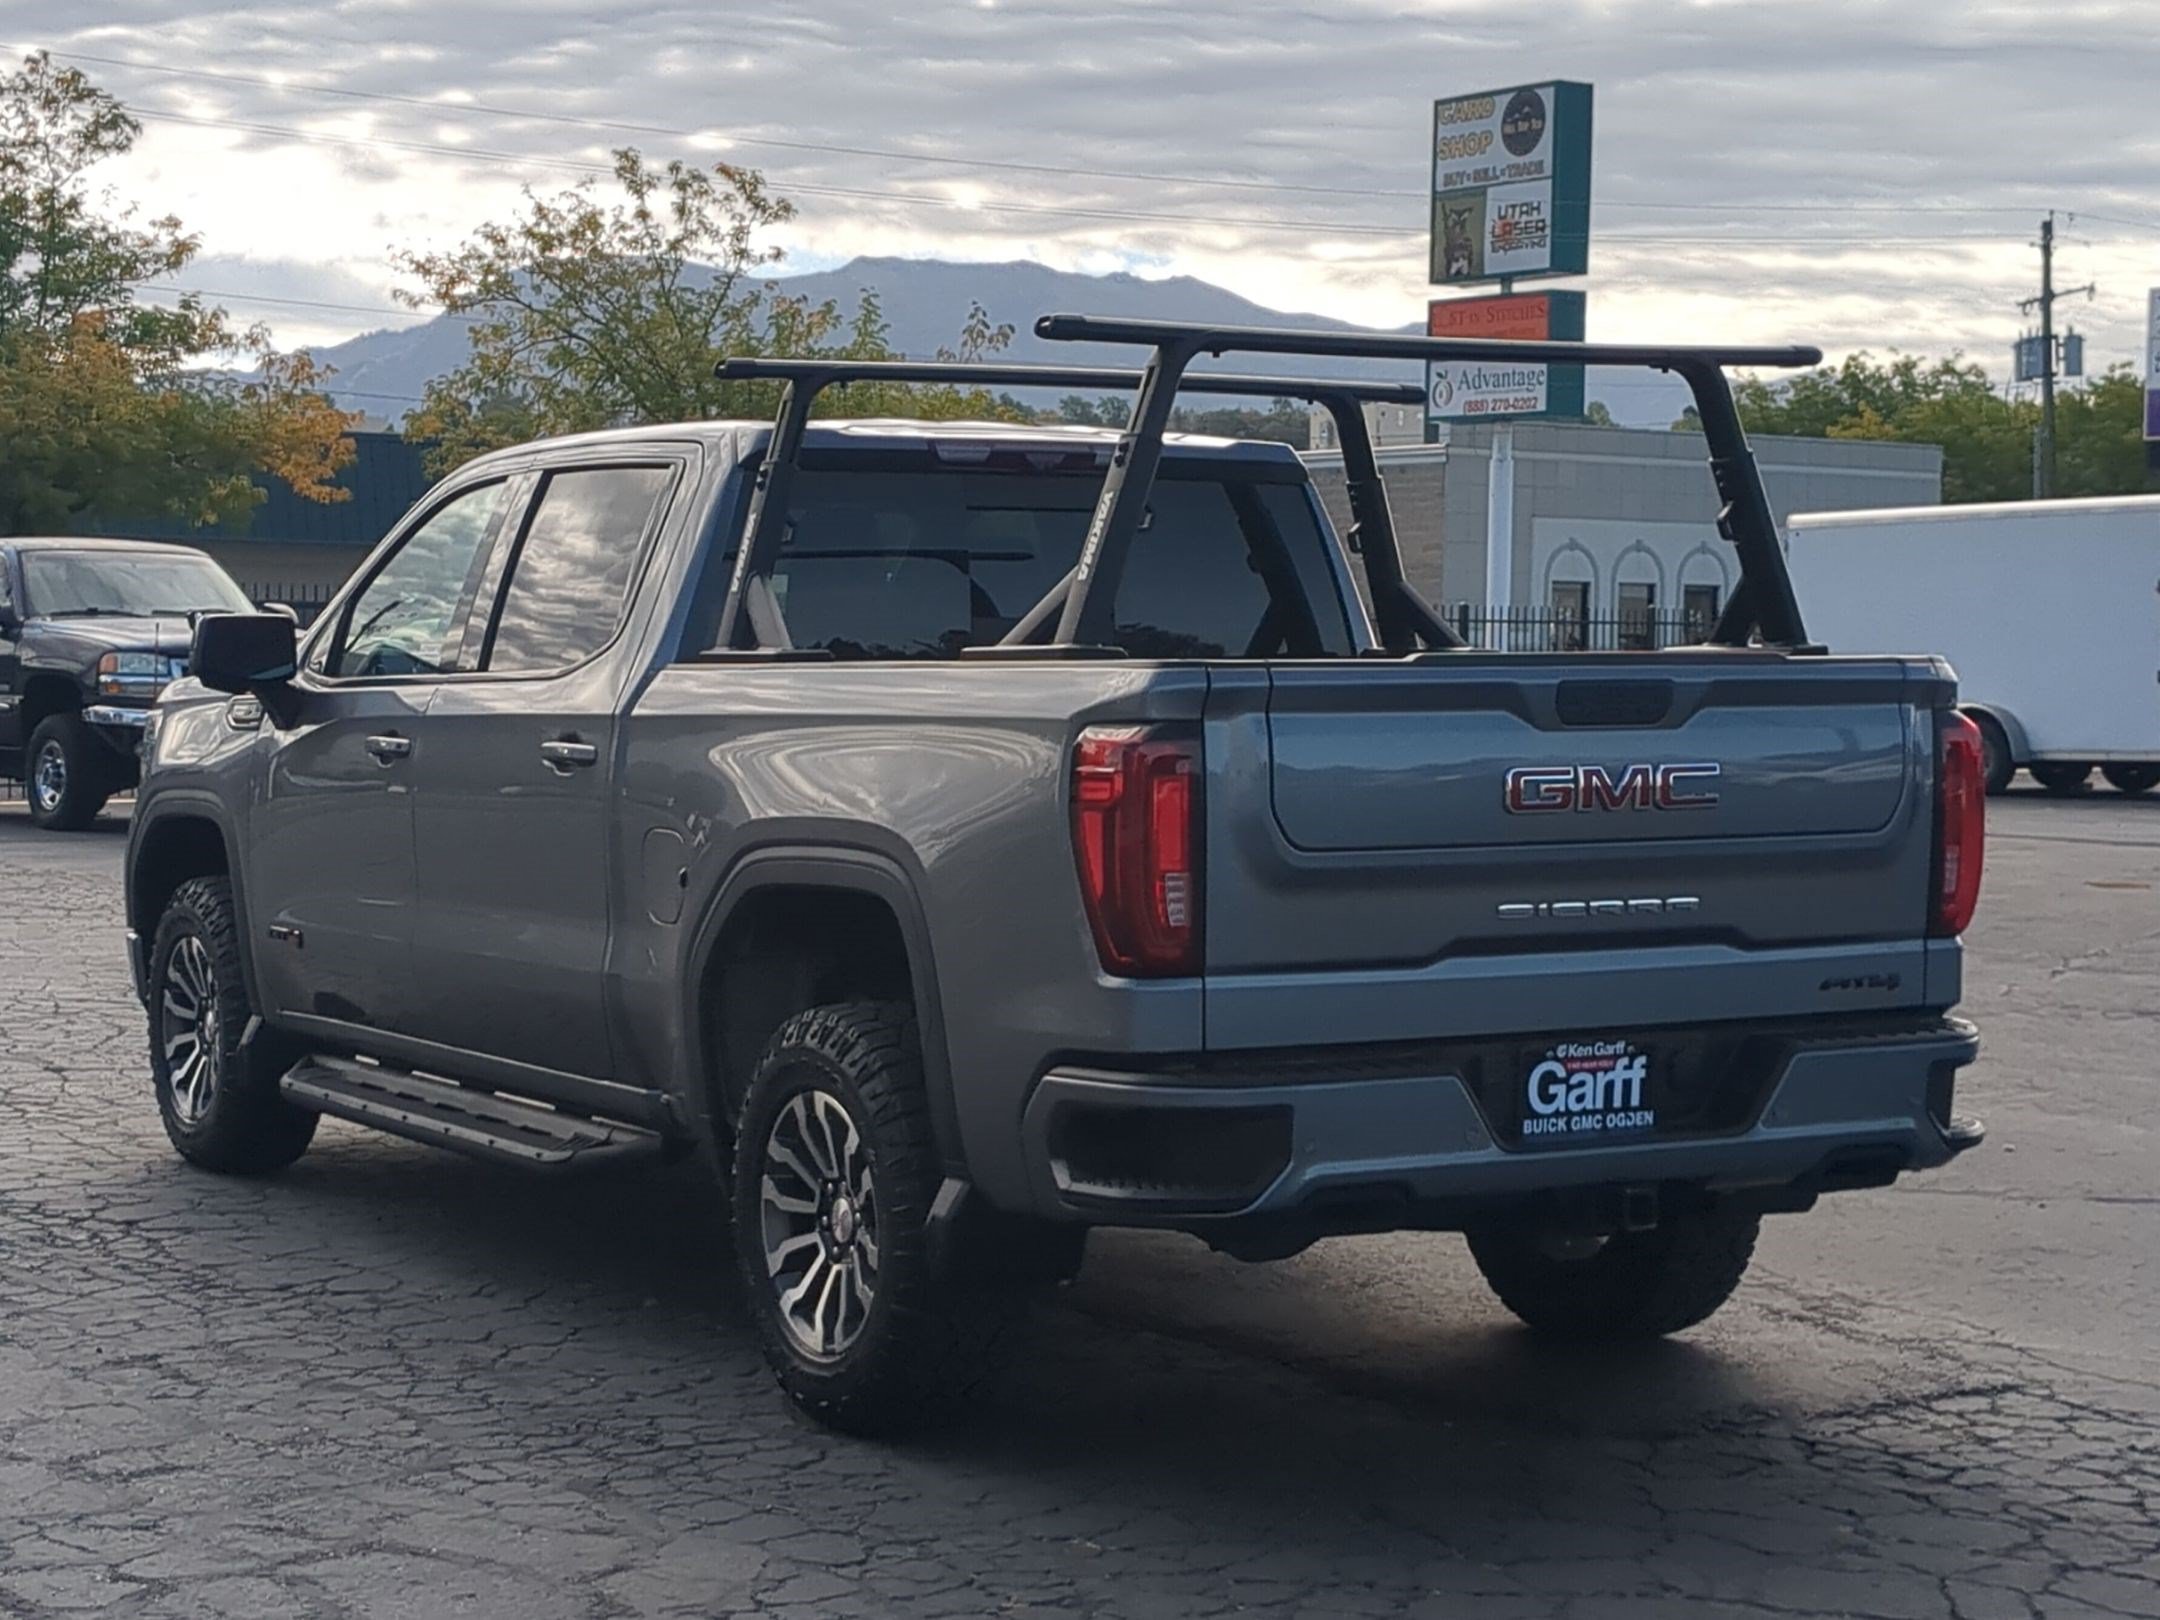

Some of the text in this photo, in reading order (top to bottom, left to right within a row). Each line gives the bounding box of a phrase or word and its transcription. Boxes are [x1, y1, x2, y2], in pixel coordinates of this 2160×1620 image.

[1438, 97, 1495, 125] CARD
[1438, 130, 1494, 160] SHOP
[1498, 201, 1541, 220] UTAH
[1491, 219, 1546, 238] LASER
[1457, 367, 1546, 392] Advantage
[1077, 491, 1114, 581] YAKIMA
[1505, 763, 1721, 814] GMC
[1498, 897, 1700, 919] SIERRA
[1527, 1056, 1648, 1115] Garff
[1522, 1110, 1654, 1135] BUICK GMC OGDEN
